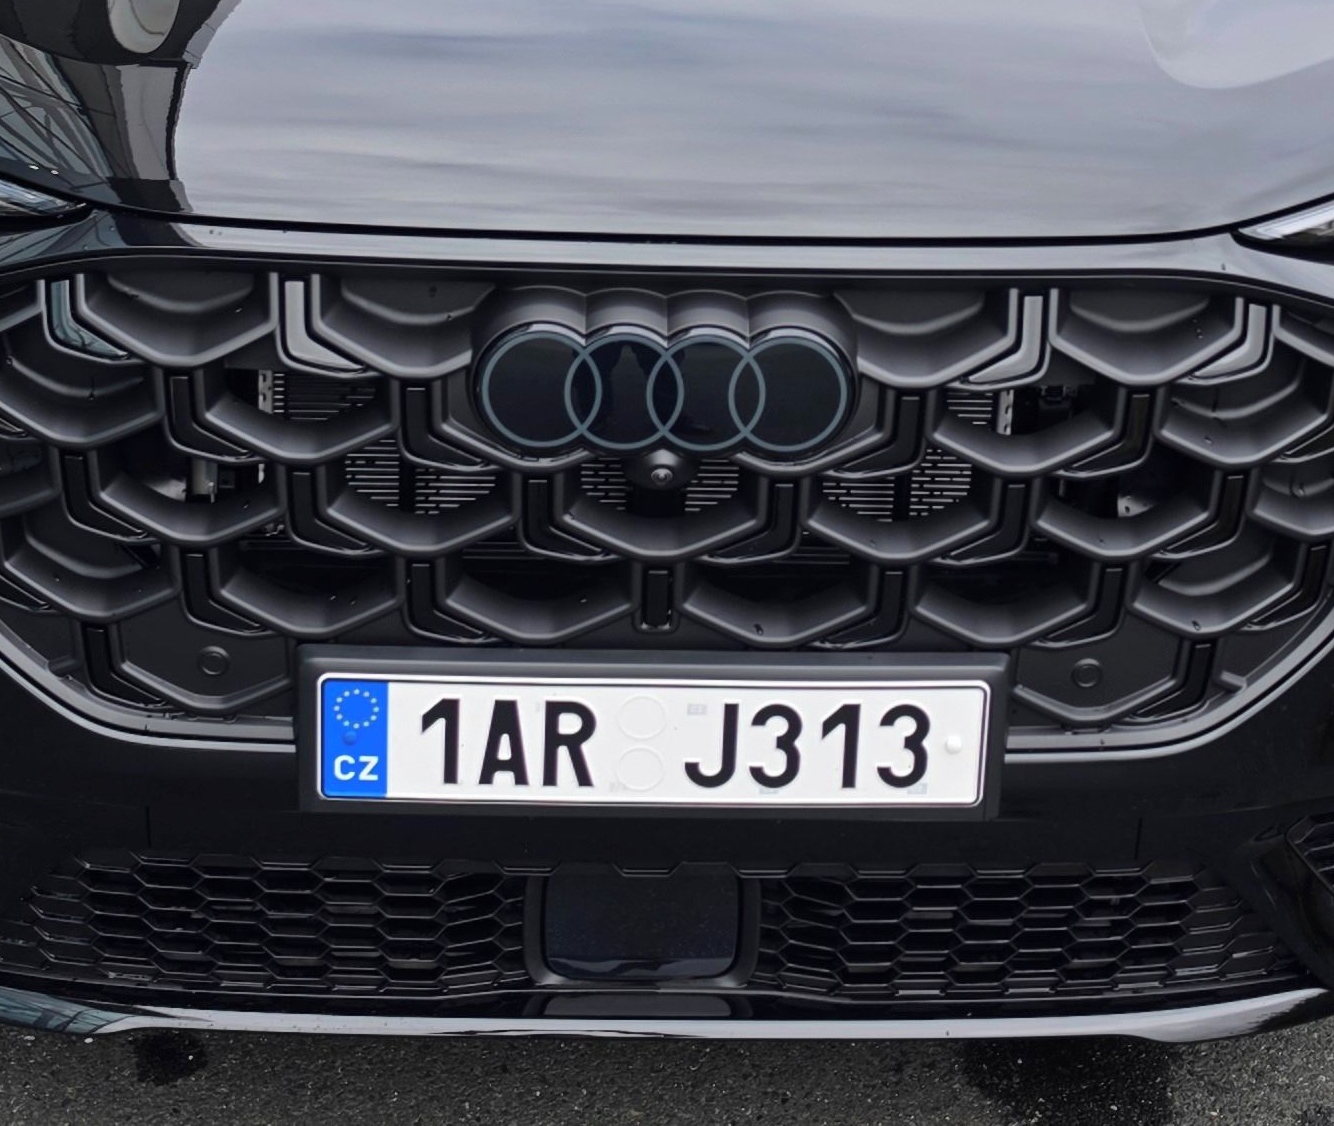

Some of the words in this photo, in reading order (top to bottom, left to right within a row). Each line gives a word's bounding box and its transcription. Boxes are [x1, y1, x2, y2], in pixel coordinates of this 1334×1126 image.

[334, 755, 379, 781] CZ
[422, 699, 595, 786] 1AR
[685, 704, 929, 788] J313
